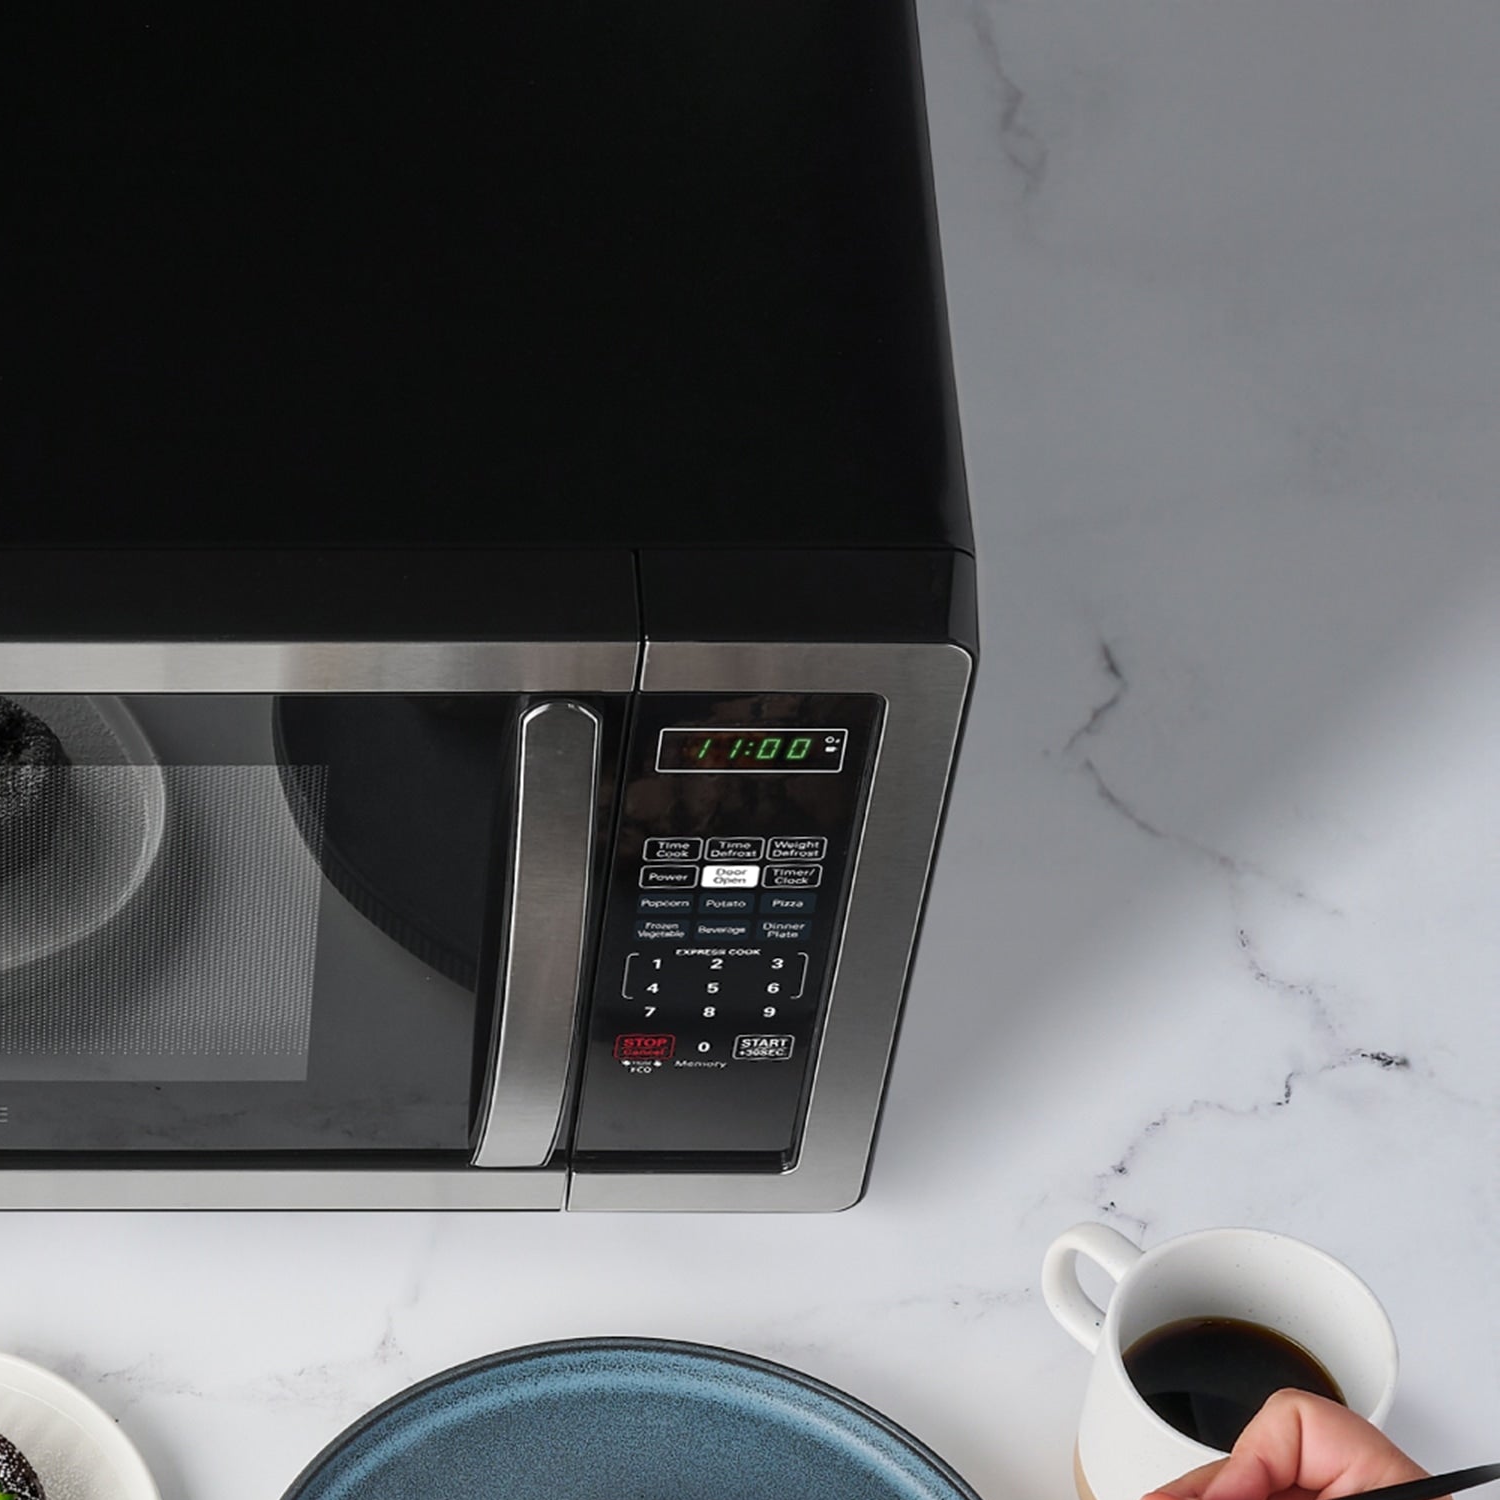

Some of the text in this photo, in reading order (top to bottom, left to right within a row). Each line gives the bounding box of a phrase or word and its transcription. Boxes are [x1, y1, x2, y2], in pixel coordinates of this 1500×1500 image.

[698, 738, 812, 759] 11:00
[658, 842, 690, 850] Time
[773, 841, 820, 850] Weight
[656, 850, 689, 858] Cook
[710, 849, 757, 858] Defrost
[772, 849, 819, 857] Defrost
[649, 873, 688, 881] Power
[772, 869, 815, 877] Timer/
[713, 876, 747, 885] Open
[774, 877, 809, 885] Clock
[640, 900, 690, 908] Popcorn
[705, 900, 747, 908] Potato
[772, 900, 804, 908] Pizza
[645, 922, 679, 930] Frozen
[698, 925, 746, 935] Beverage
[763, 922, 805, 930] Dinner
[638, 930, 685, 939] Vegetable
[652, 959, 662, 969] 1
[710, 959, 723, 969] 2
[771, 958, 784, 969] 3
[646, 983, 659, 993] 4
[707, 983, 719, 993] 5
[767, 983, 780, 993] 6
[644, 1007, 656, 1017] 7
[703, 1007, 716, 1017] 8
[763, 1007, 776, 1017] 9
[623, 1038, 668, 1047] STOP
[698, 1042, 711, 1052] 0
[741, 1039, 788, 1048] START
[675, 1060, 727, 1069] Memory
